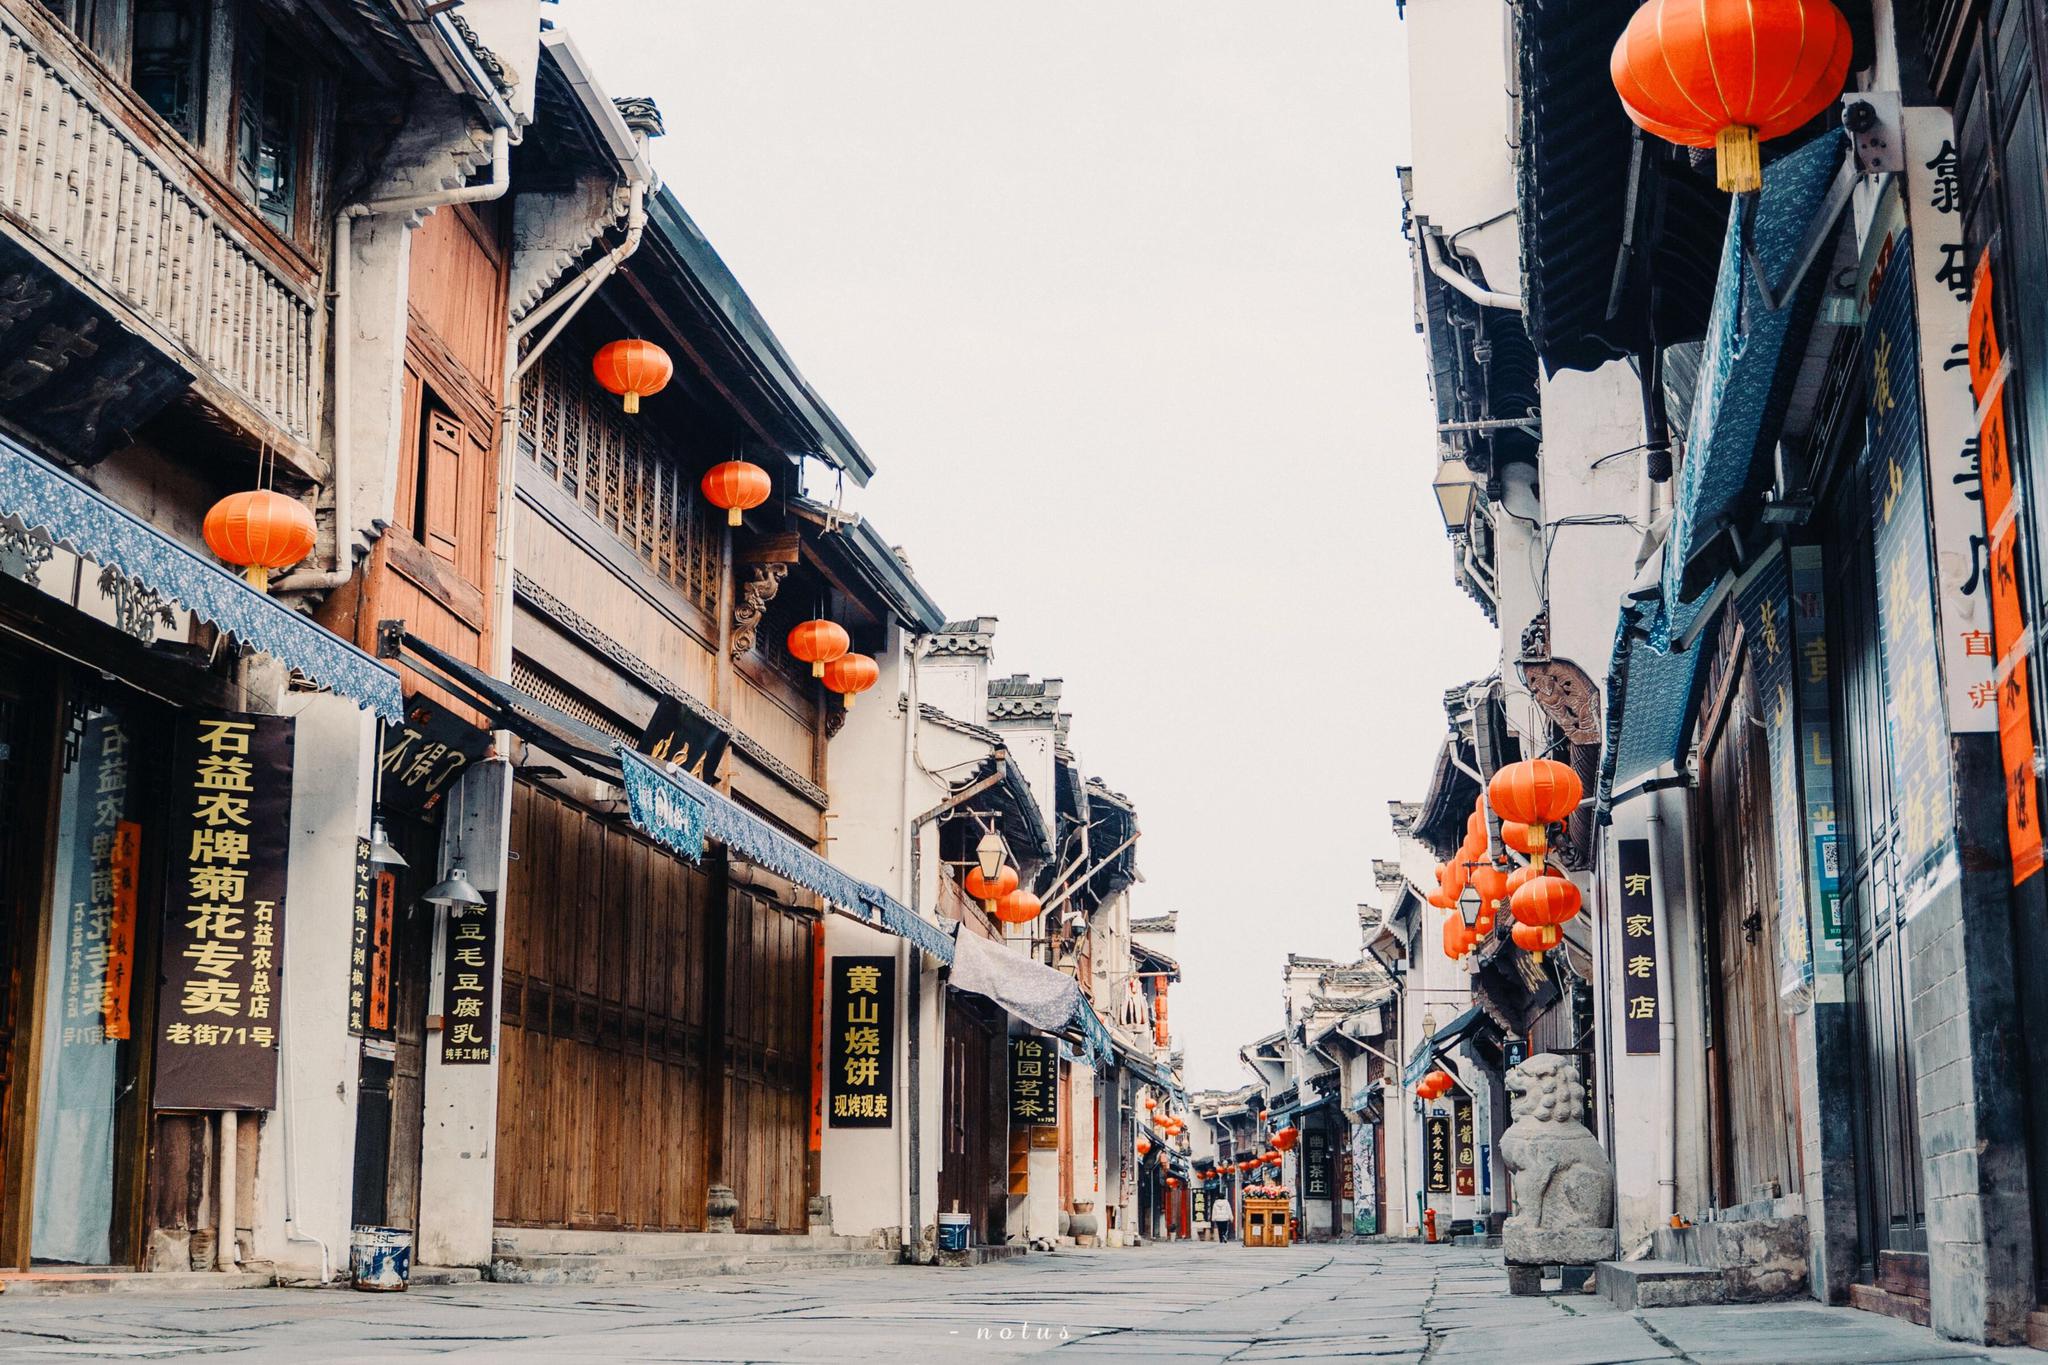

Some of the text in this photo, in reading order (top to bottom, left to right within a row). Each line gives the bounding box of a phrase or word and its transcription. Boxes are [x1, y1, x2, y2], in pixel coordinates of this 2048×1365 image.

[181, 719, 256, 1017] 石益农牌菊花专卖
[248, 901, 277, 1020] 石益农总店
[1624, 873, 1656, 1020] 有家老店
[166, 1022, 276, 1048] 老街71号
[445, 1048, 490, 1060] 纯手工制作
[844, 965, 882, 1087] 黄山烧饼
[834, 1093, 888, 1118] 现烤现卖
[1013, 1039, 1044, 1117] 怡园茗茶
